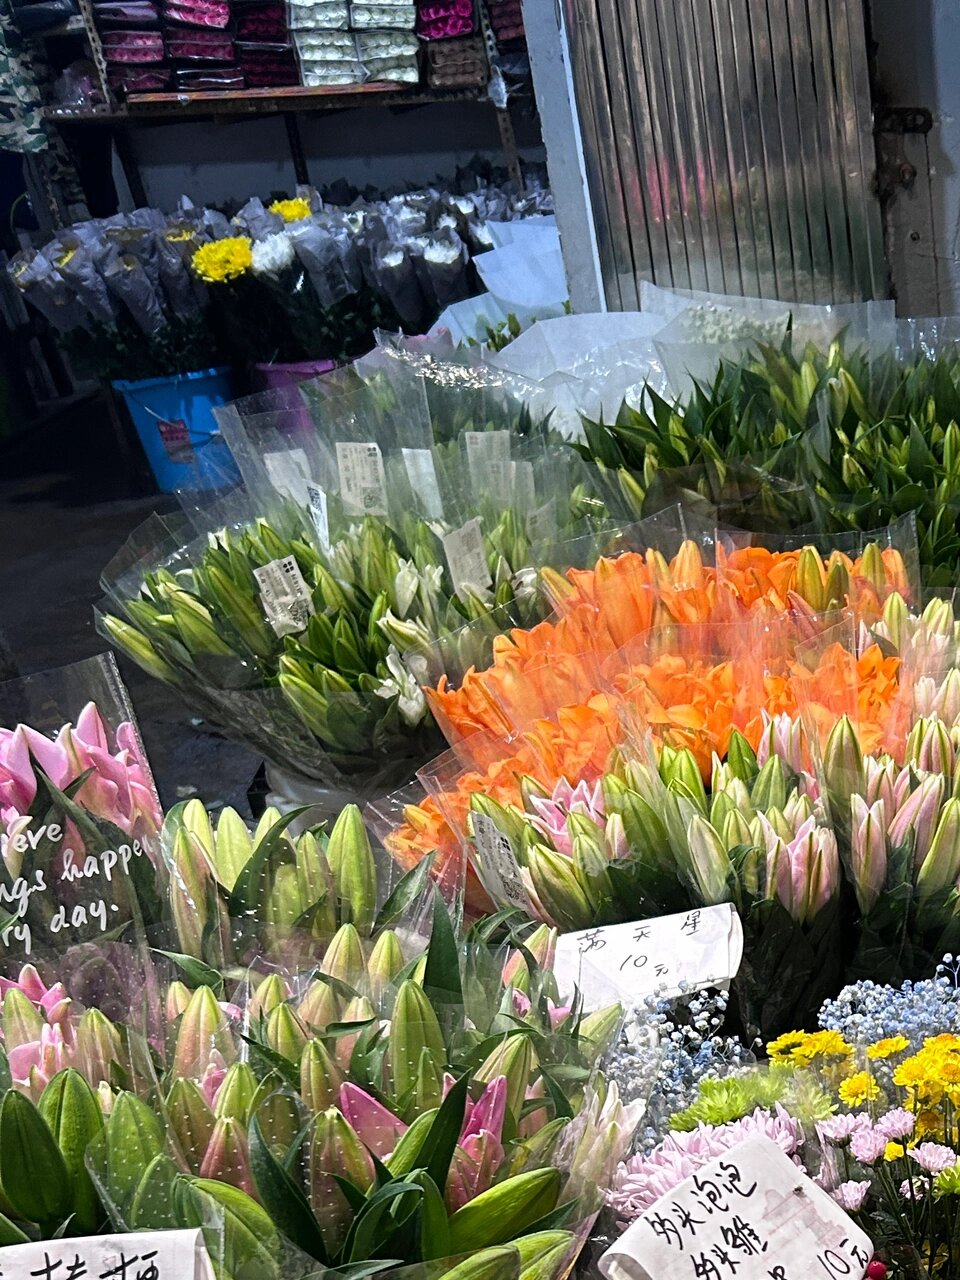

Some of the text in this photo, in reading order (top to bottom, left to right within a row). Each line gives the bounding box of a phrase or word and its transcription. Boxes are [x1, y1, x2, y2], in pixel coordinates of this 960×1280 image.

[50, 899, 119, 933] day.
[577, 910, 701, 954] 满天星
[619, 954, 669, 977] 10元
